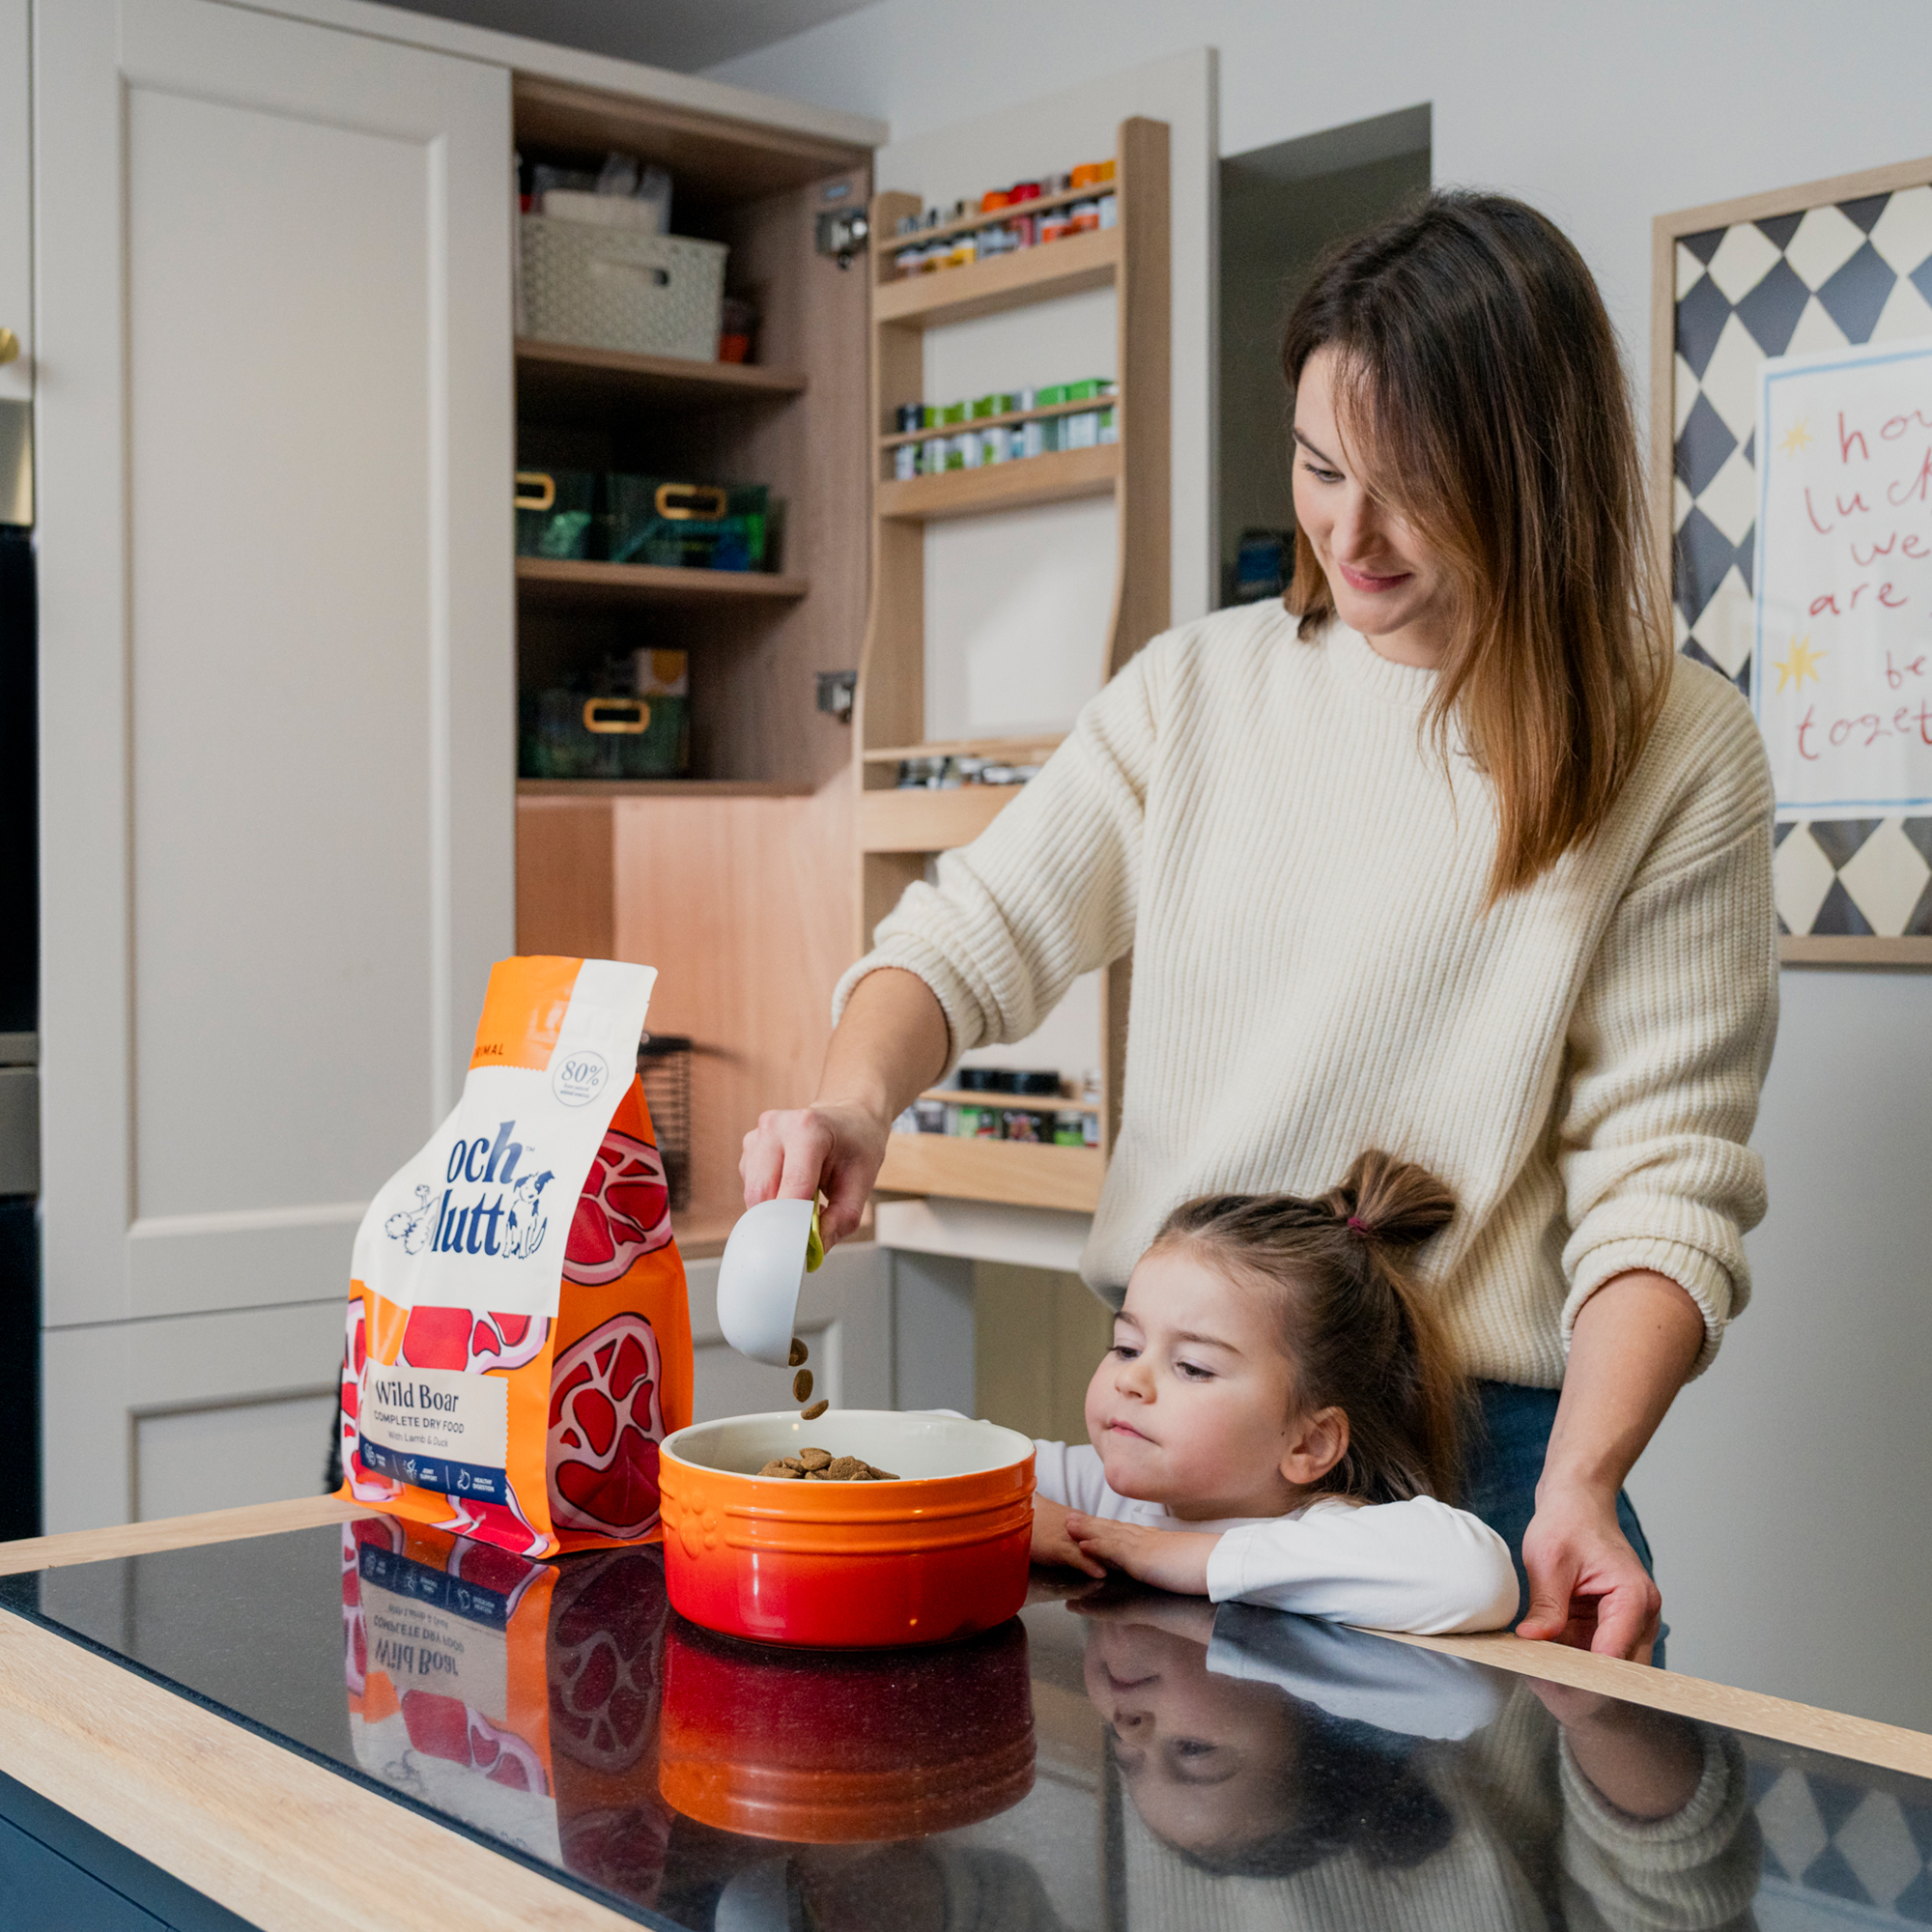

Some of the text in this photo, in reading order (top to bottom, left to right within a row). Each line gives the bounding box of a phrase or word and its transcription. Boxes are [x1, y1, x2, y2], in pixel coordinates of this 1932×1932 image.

[1850, 531, 1931, 567] we
[1809, 582, 1909, 616] are
[1885, 649, 1926, 690] be
[561, 1061, 603, 1086] 80%
[447, 1121, 523, 1183] och
[431, 1189, 504, 1256] lutt
[376, 1379, 459, 1412] Wild Boar
[374, 1410, 465, 1434] COMPLETE DRY FOOD
[388, 1431, 403, 1441] With
[405, 1434, 425, 1444] Lamb
[434, 1437, 448, 1447] Duck
